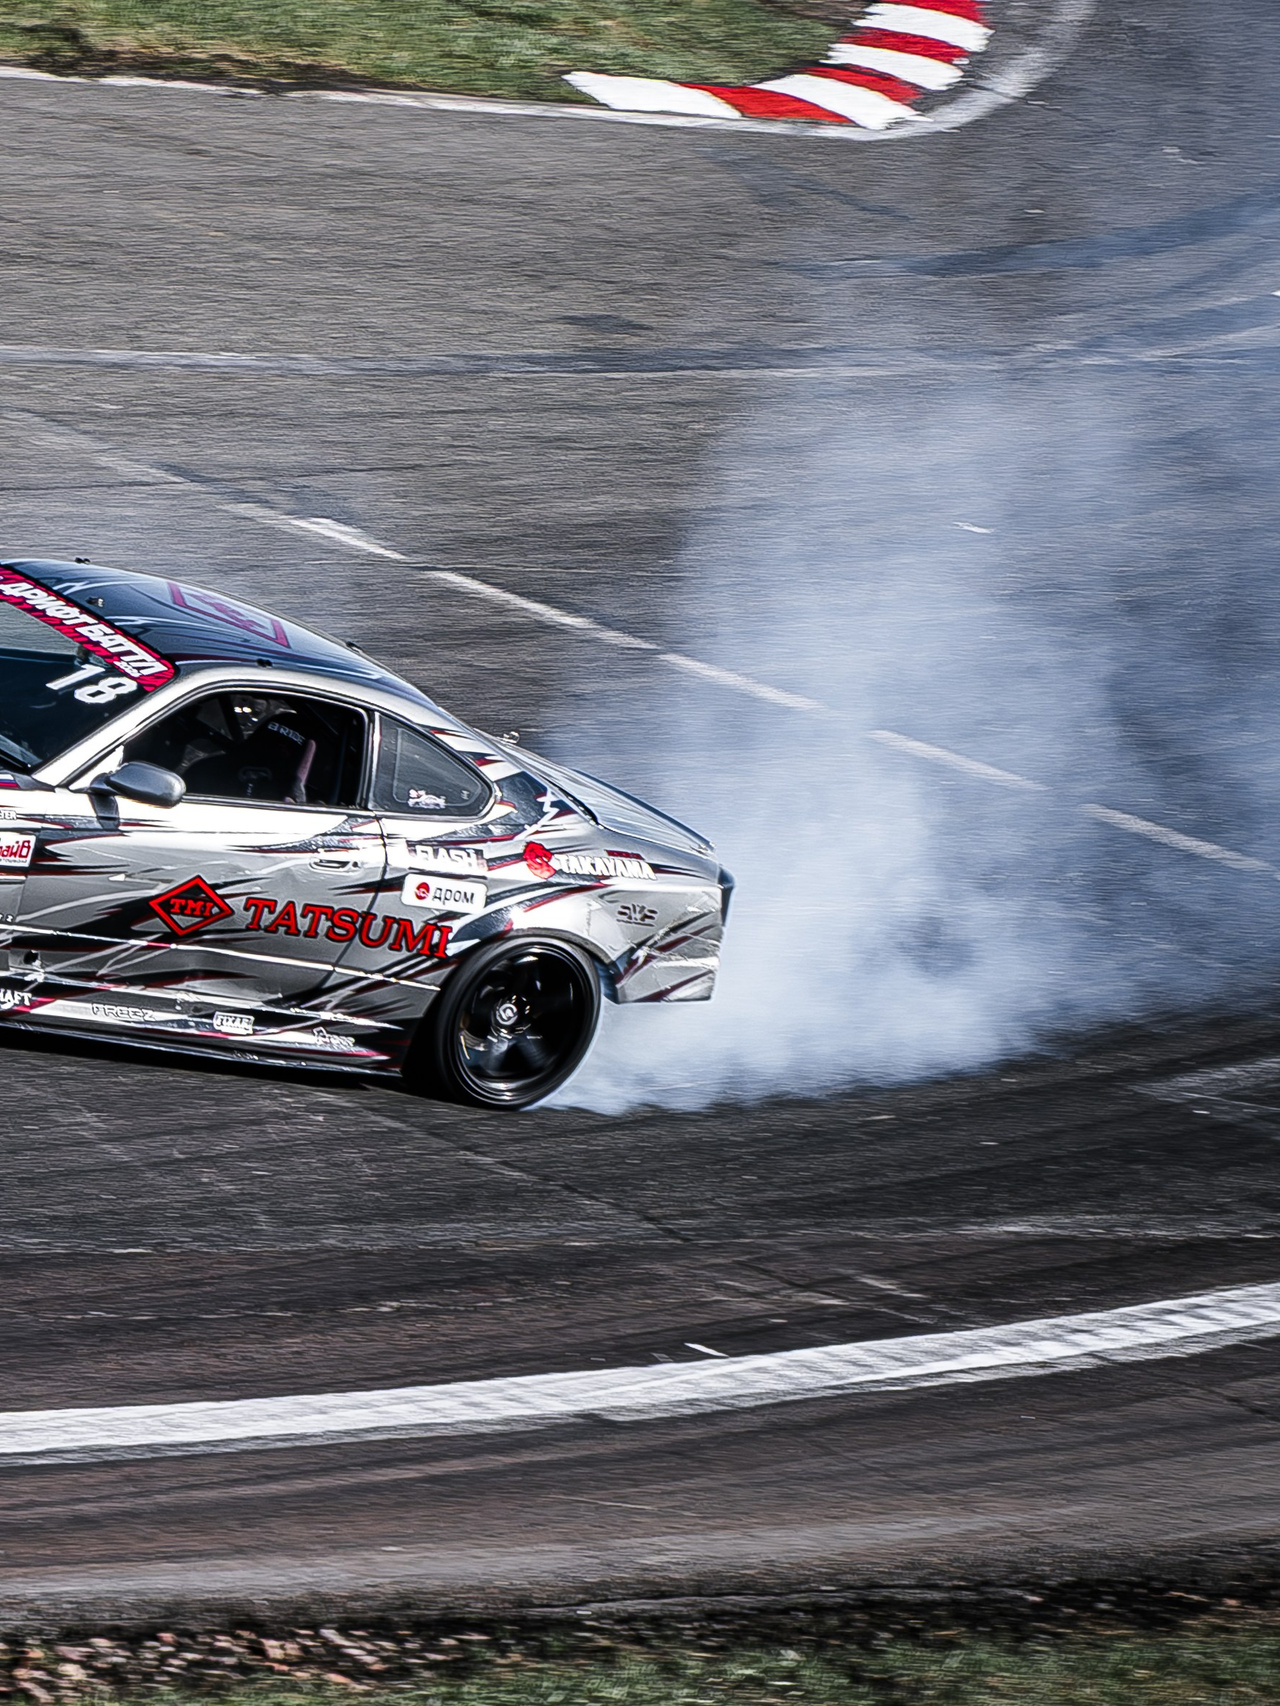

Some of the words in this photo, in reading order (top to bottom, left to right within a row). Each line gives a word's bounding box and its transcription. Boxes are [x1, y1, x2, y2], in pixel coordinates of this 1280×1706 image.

[45, 664, 138, 704] 18
[267, 721, 306, 746] BRIDE
[553, 854, 658, 881] TAKAYAMA
[169, 898, 214, 918] TMI
[243, 896, 454, 959] TATSUMI
